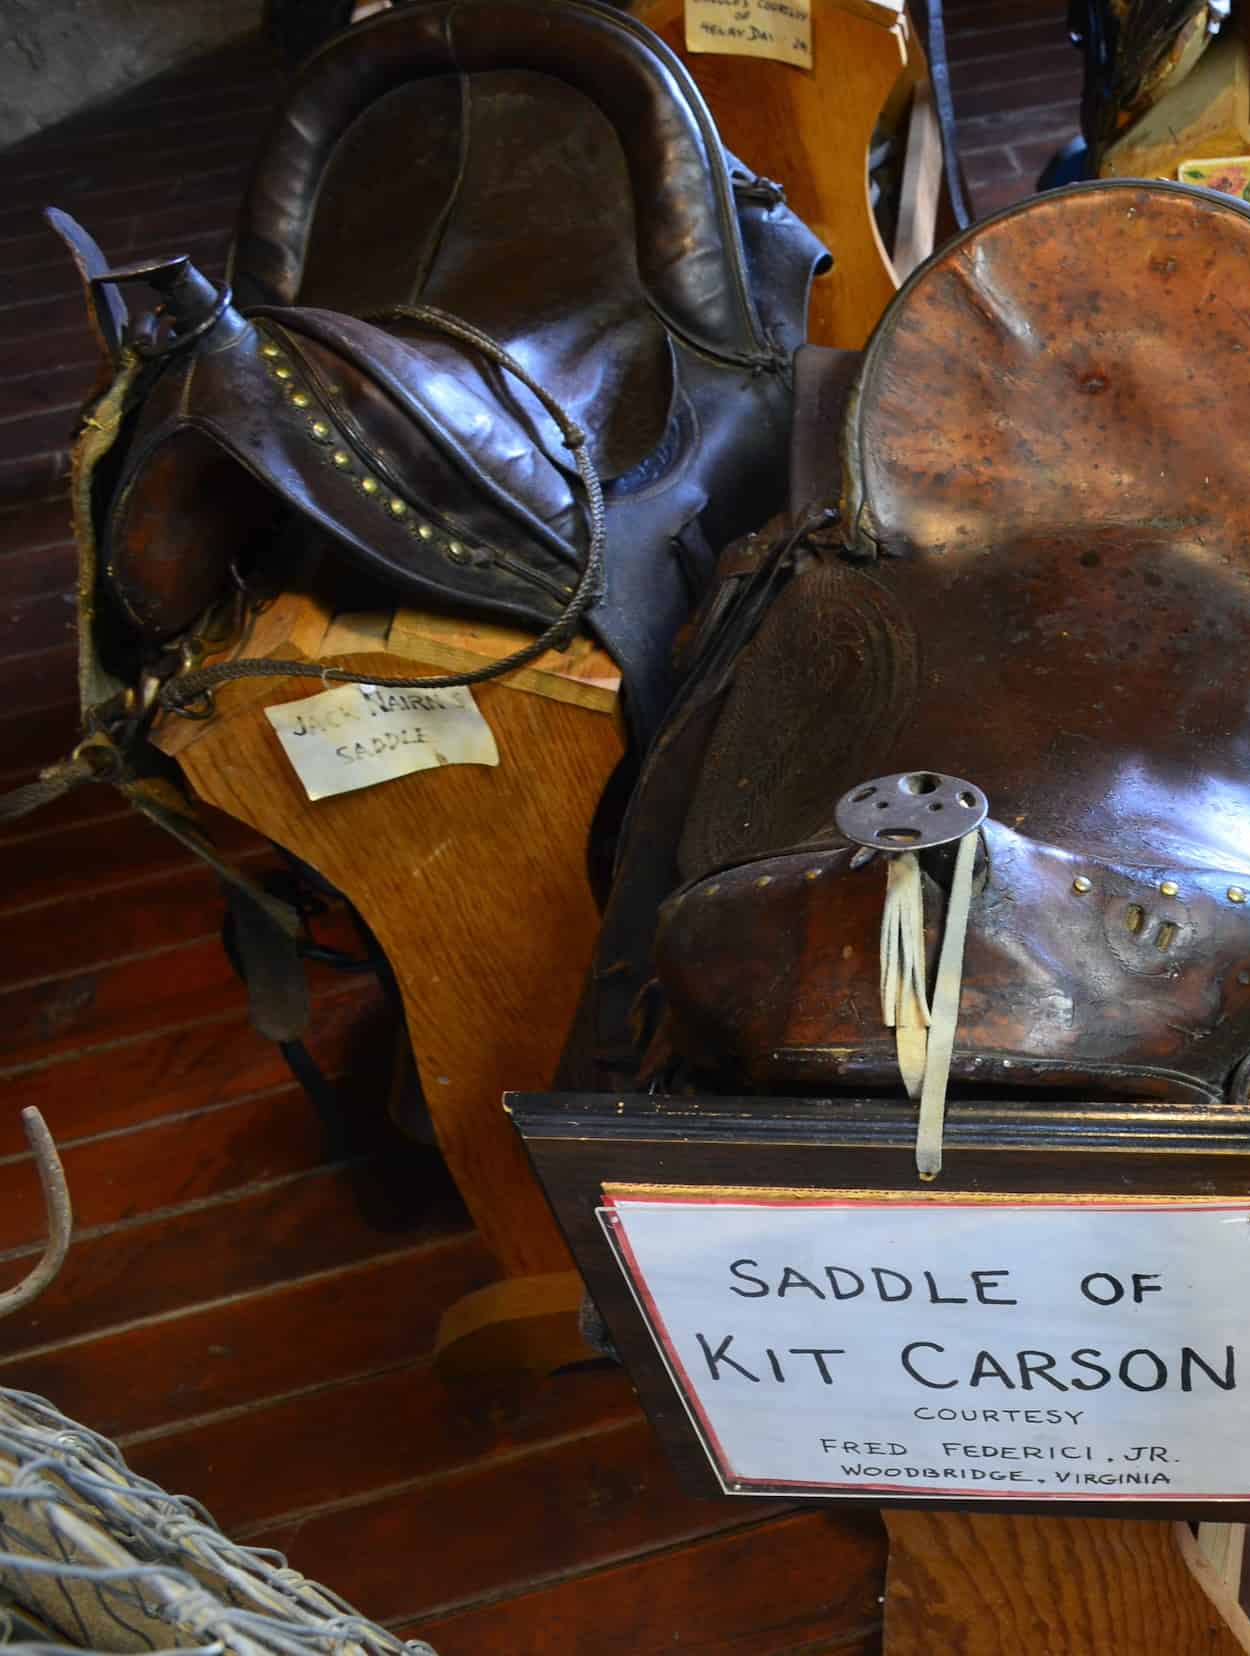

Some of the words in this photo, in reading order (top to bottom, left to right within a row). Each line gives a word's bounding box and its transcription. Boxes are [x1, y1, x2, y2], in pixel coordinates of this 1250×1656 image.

[335, 726, 430, 766] SADDLE
[729, 1258, 1018, 1305] SADDLE
[1080, 1272, 1163, 1306] OF
[695, 1332, 846, 1386] KIT
[900, 1340, 1237, 1393] CARSON
[913, 1406, 1085, 1426] COURTESY
[819, 1438, 909, 1457] FRED
[1054, 1470, 1172, 1486] VIRGINIA
